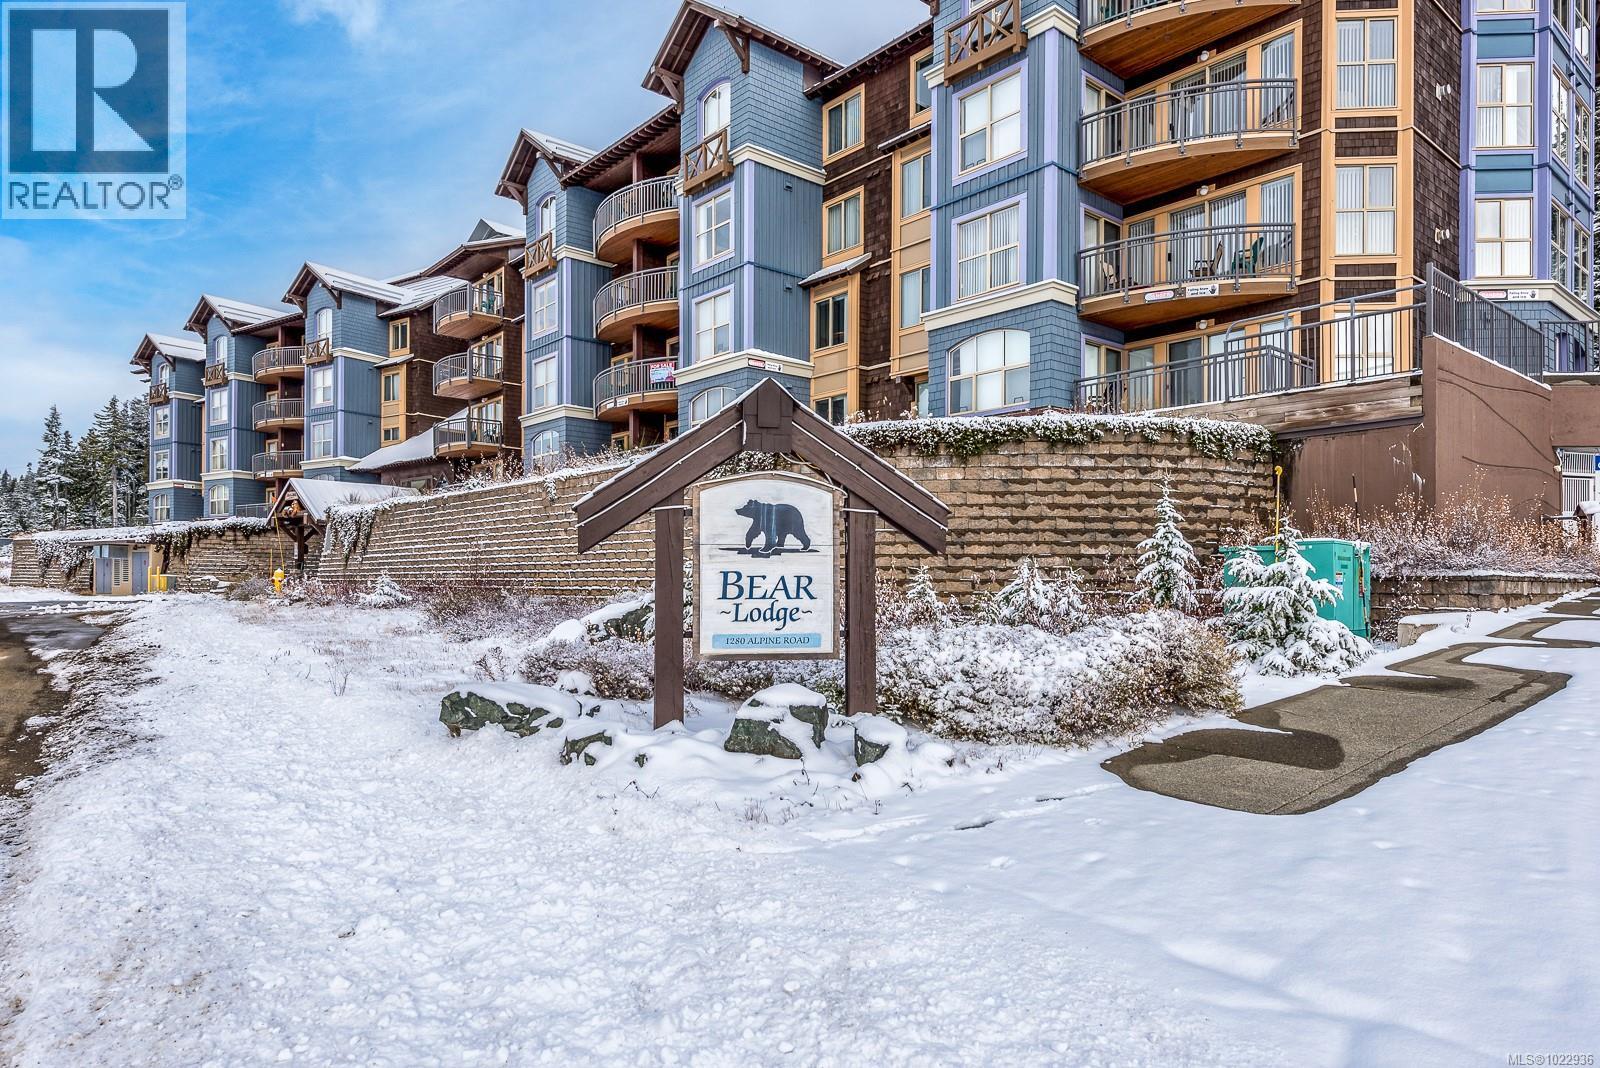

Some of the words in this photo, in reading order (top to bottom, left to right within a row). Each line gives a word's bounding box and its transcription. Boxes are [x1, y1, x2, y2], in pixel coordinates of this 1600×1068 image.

[717, 570, 817, 600] BEAR
[726, 637, 746, 645] 1280
[747, 636, 781, 645] ALPINE
[783, 636, 810, 645] ROAD
